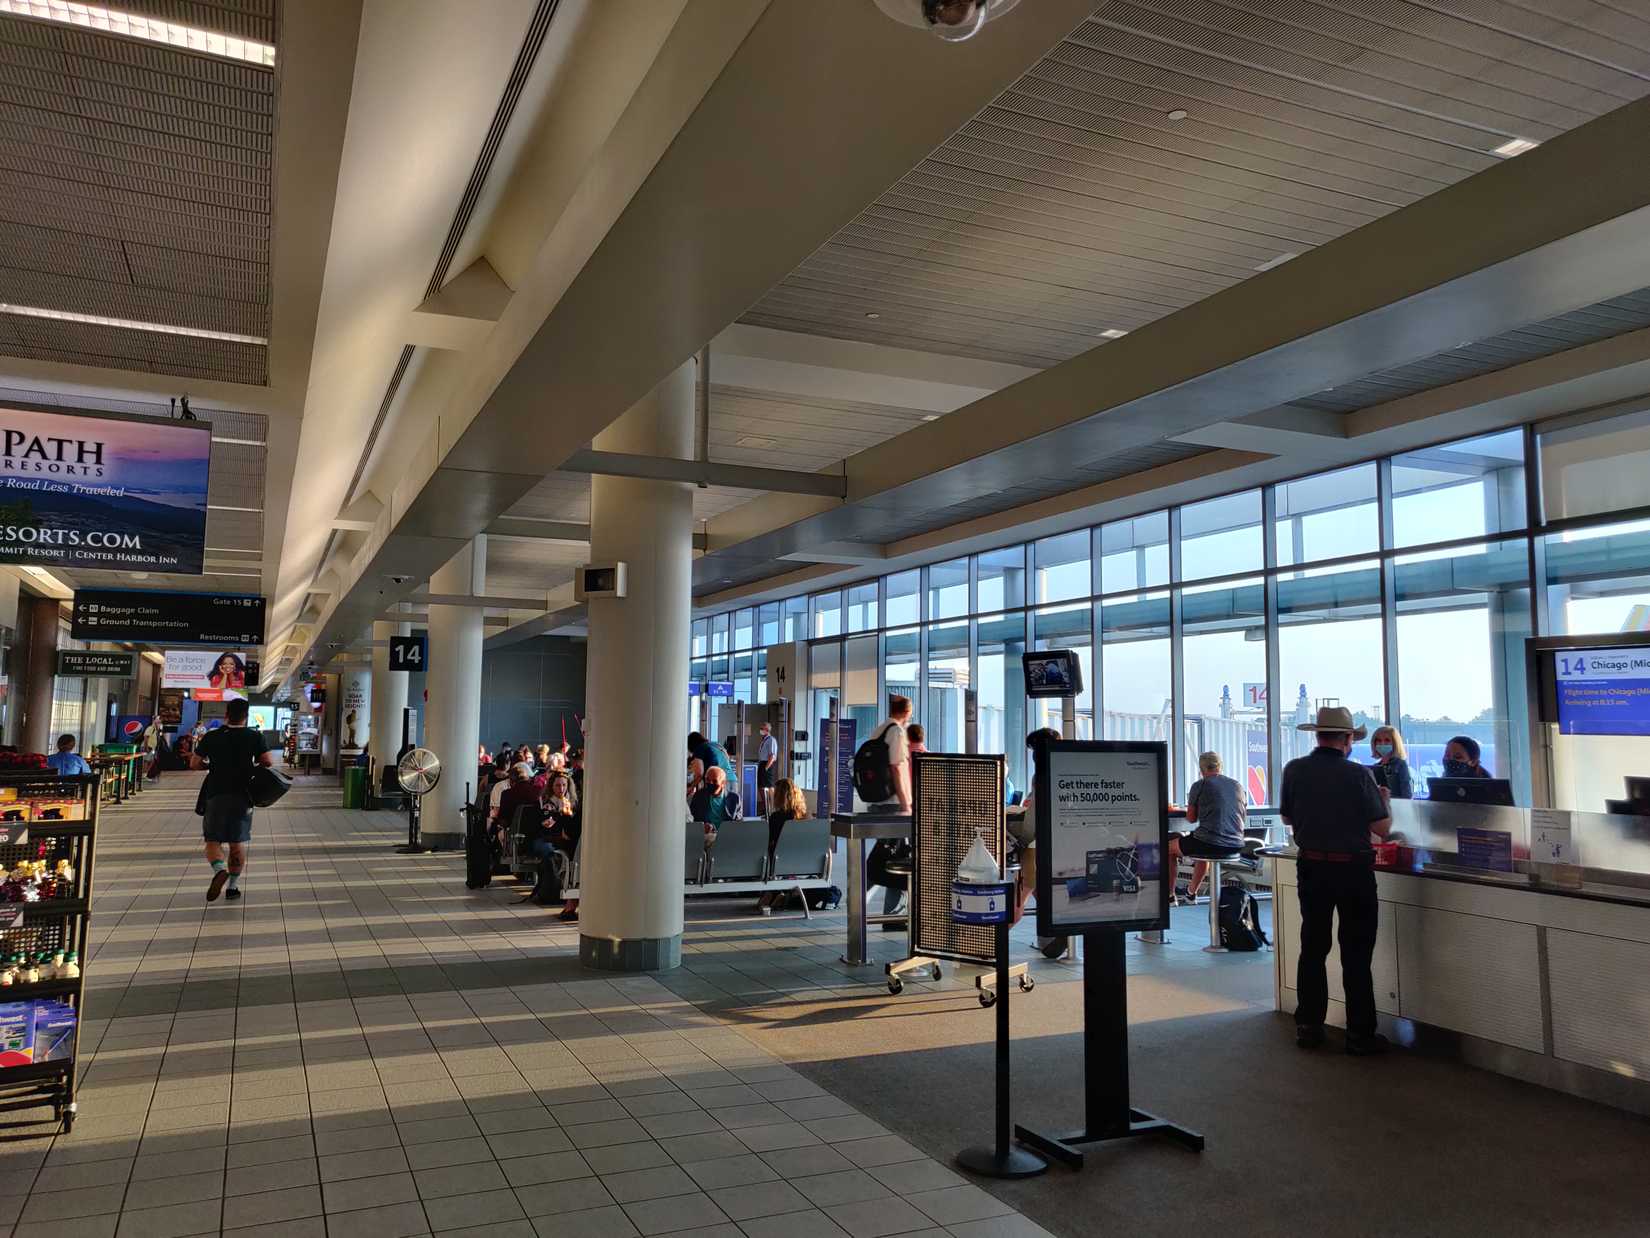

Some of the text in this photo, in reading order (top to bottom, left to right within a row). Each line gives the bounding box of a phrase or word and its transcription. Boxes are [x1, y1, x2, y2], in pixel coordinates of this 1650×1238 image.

[2, 429, 105, 466] PATH
[4, 459, 104, 477] RESORTS
[7, 478, 40, 490] Road
[42, 481, 69, 493] Less
[72, 483, 125, 497] Traveled
[28, 547, 65, 558] RESORT
[75, 550, 114, 561] CENTER
[116, 552, 157, 564] HARBOR
[159, 555, 178, 564] INN
[100, 606, 160, 615] Baggage Claim
[100, 617, 189, 628] Ground Transportation
[200, 633, 240, 642] Restrooms
[64, 656, 83, 664] THE
[85, 657, 113, 665] LOCAL
[395, 645, 422, 664] 14
[776, 666, 786, 683] 14
[1561, 657, 1586, 676] 14
[1591, 660, 1629, 671] Chicago
[1058, 779, 1125, 789] Get there faster
[1058, 793, 1079, 802] with
[1080, 792, 1110, 804] 50,000
